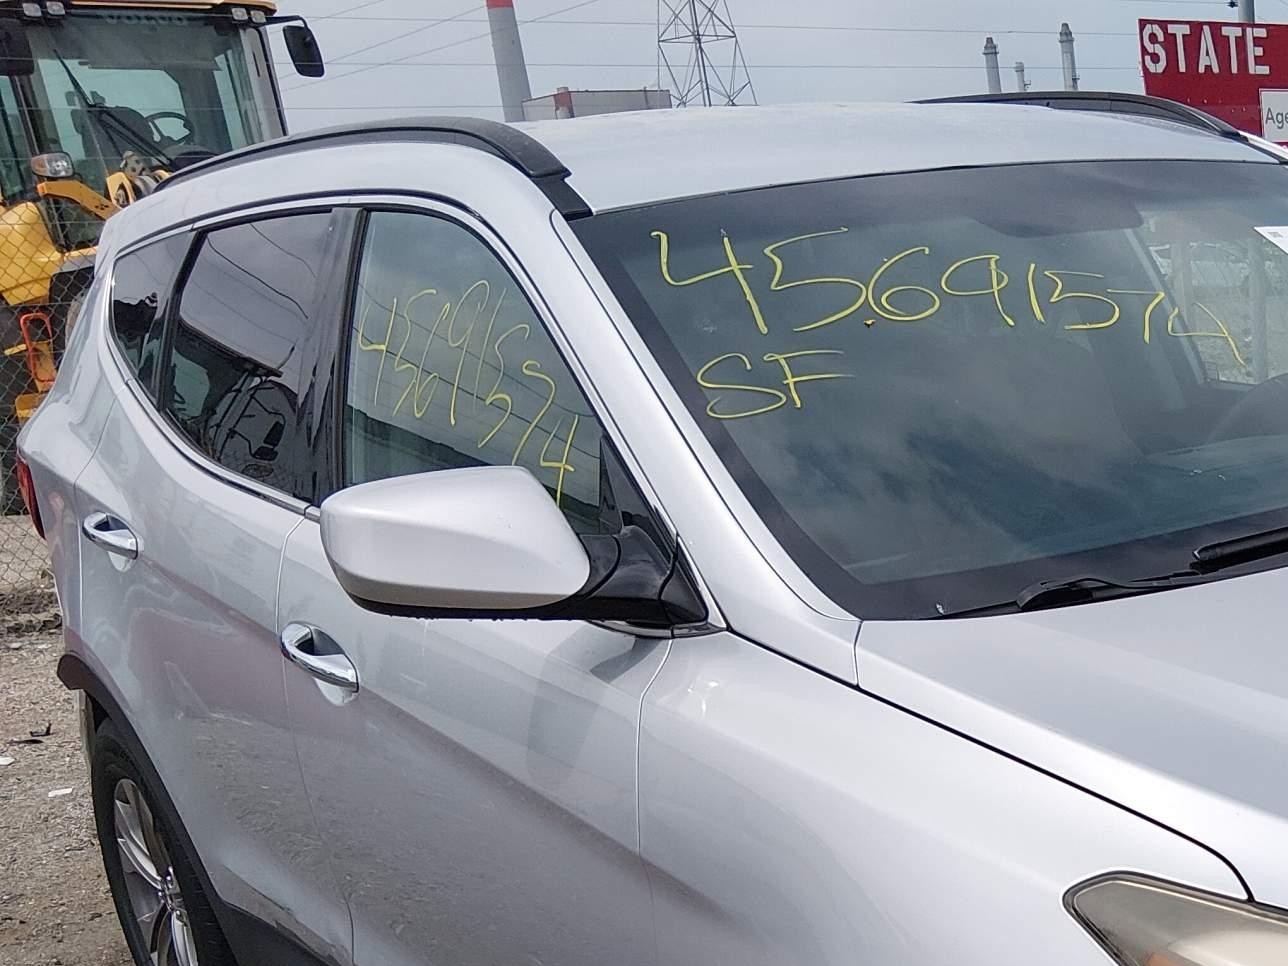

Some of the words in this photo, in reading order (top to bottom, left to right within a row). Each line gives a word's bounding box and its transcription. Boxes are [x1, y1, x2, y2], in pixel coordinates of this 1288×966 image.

[1142, 23, 1271, 75] STATE
[650, 225, 1247, 365] 45691574
[696, 348, 856, 419] SF
